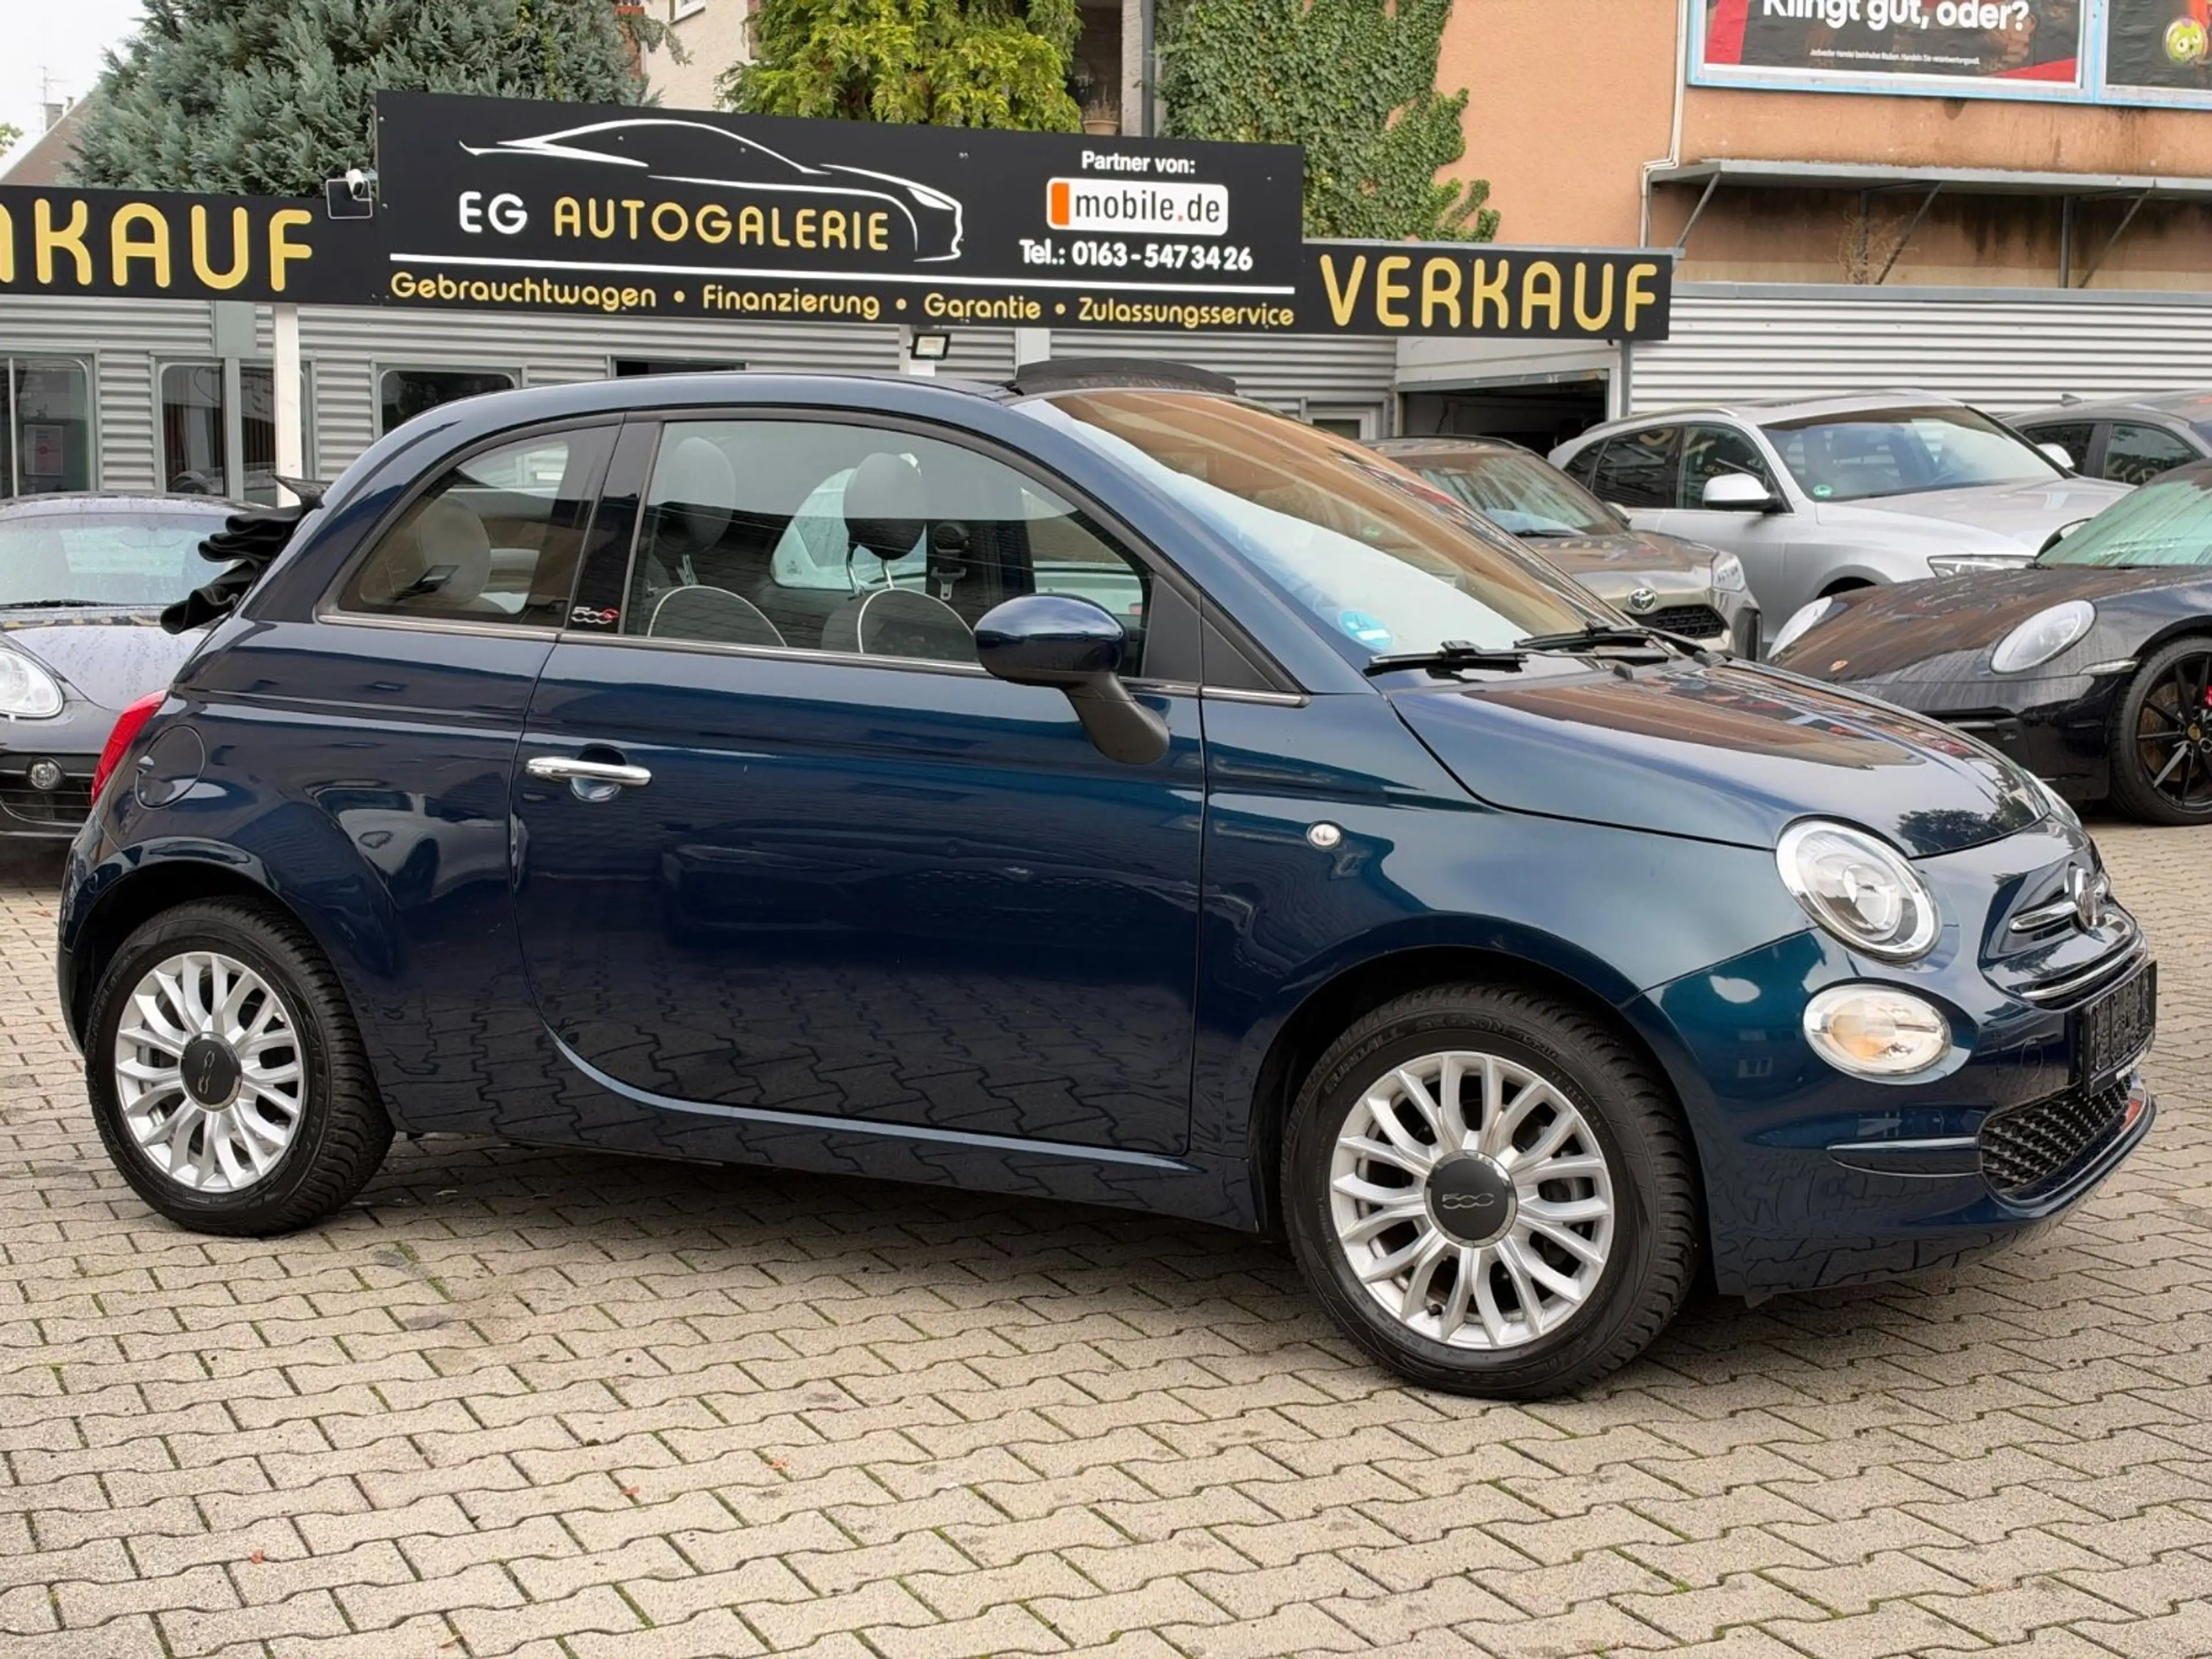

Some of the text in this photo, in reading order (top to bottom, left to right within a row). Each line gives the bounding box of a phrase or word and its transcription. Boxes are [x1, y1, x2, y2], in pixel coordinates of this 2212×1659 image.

[1763, 0, 2029, 31] Klingt gut, oder?
[1082, 150, 1195, 173] Partner von:
[459, 191, 888, 251] EG AUTOGALERIE
[1075, 190, 1220, 222] mobile.de
[0, 199, 312, 291] KAUF
[1019, 238, 1066, 265] Tel.:
[391, 271, 1294, 329] Gebrauchtwagen Finanzierung Garantie Zulassungsservice
[1320, 254, 1658, 332] VERKAUF
